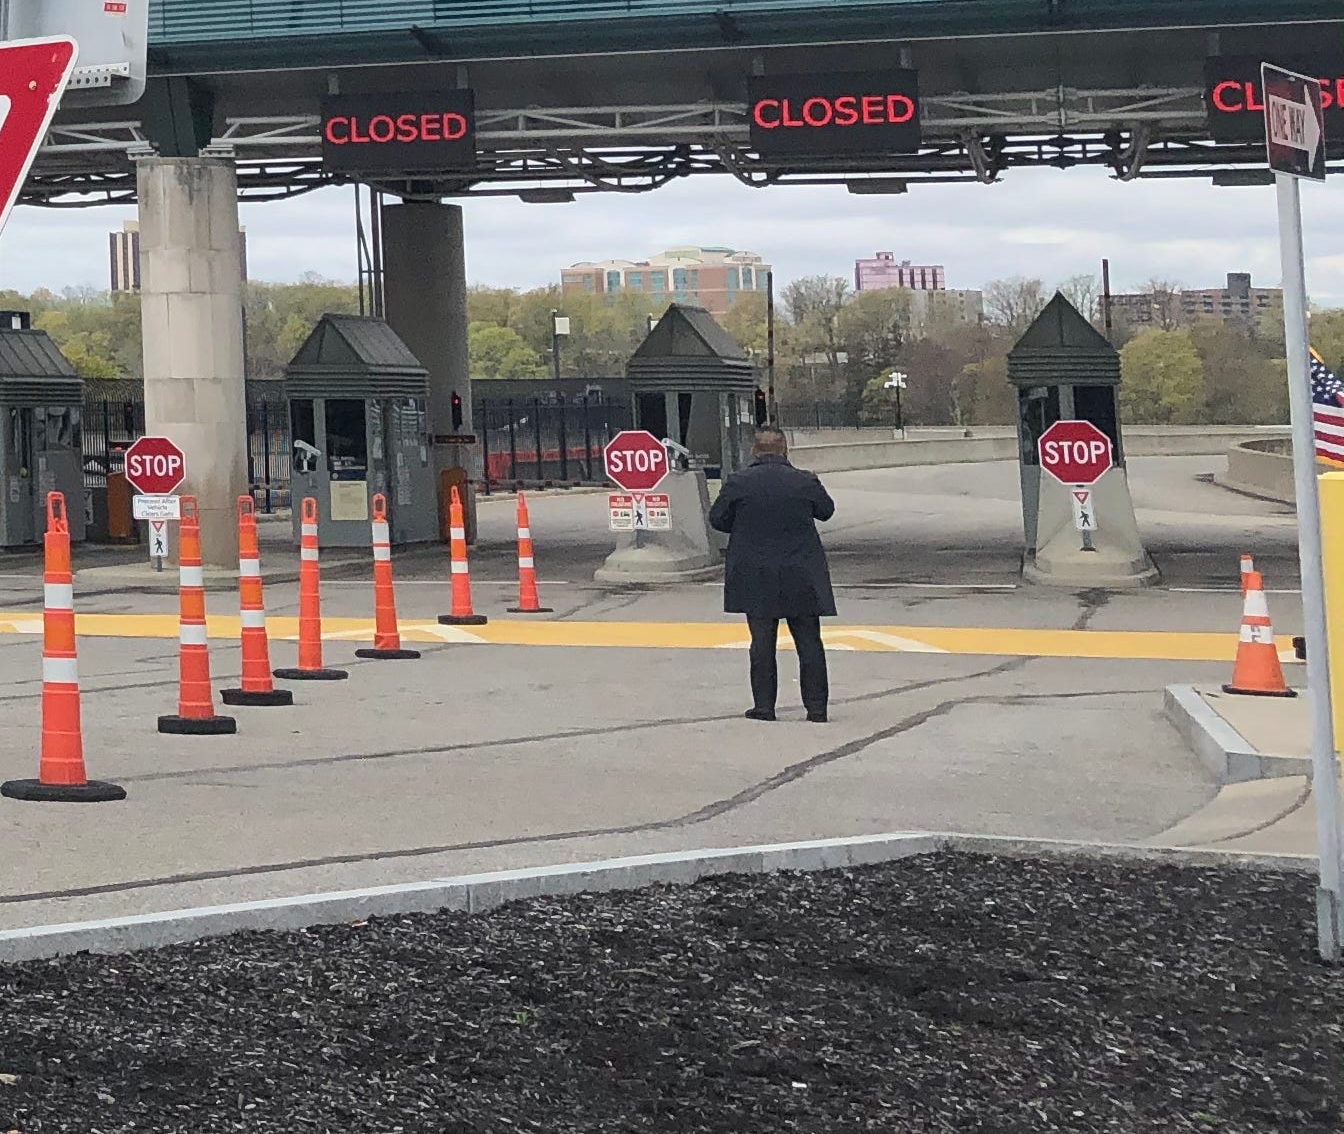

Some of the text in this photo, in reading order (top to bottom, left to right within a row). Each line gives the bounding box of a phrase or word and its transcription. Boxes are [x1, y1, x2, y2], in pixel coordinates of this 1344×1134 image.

[753, 94, 914, 128] CLOSED
[325, 113, 467, 144] CLOSED
[610, 450, 663, 472] STOP
[1044, 441, 1105, 464] STOP
[130, 455, 181, 476] STOP
